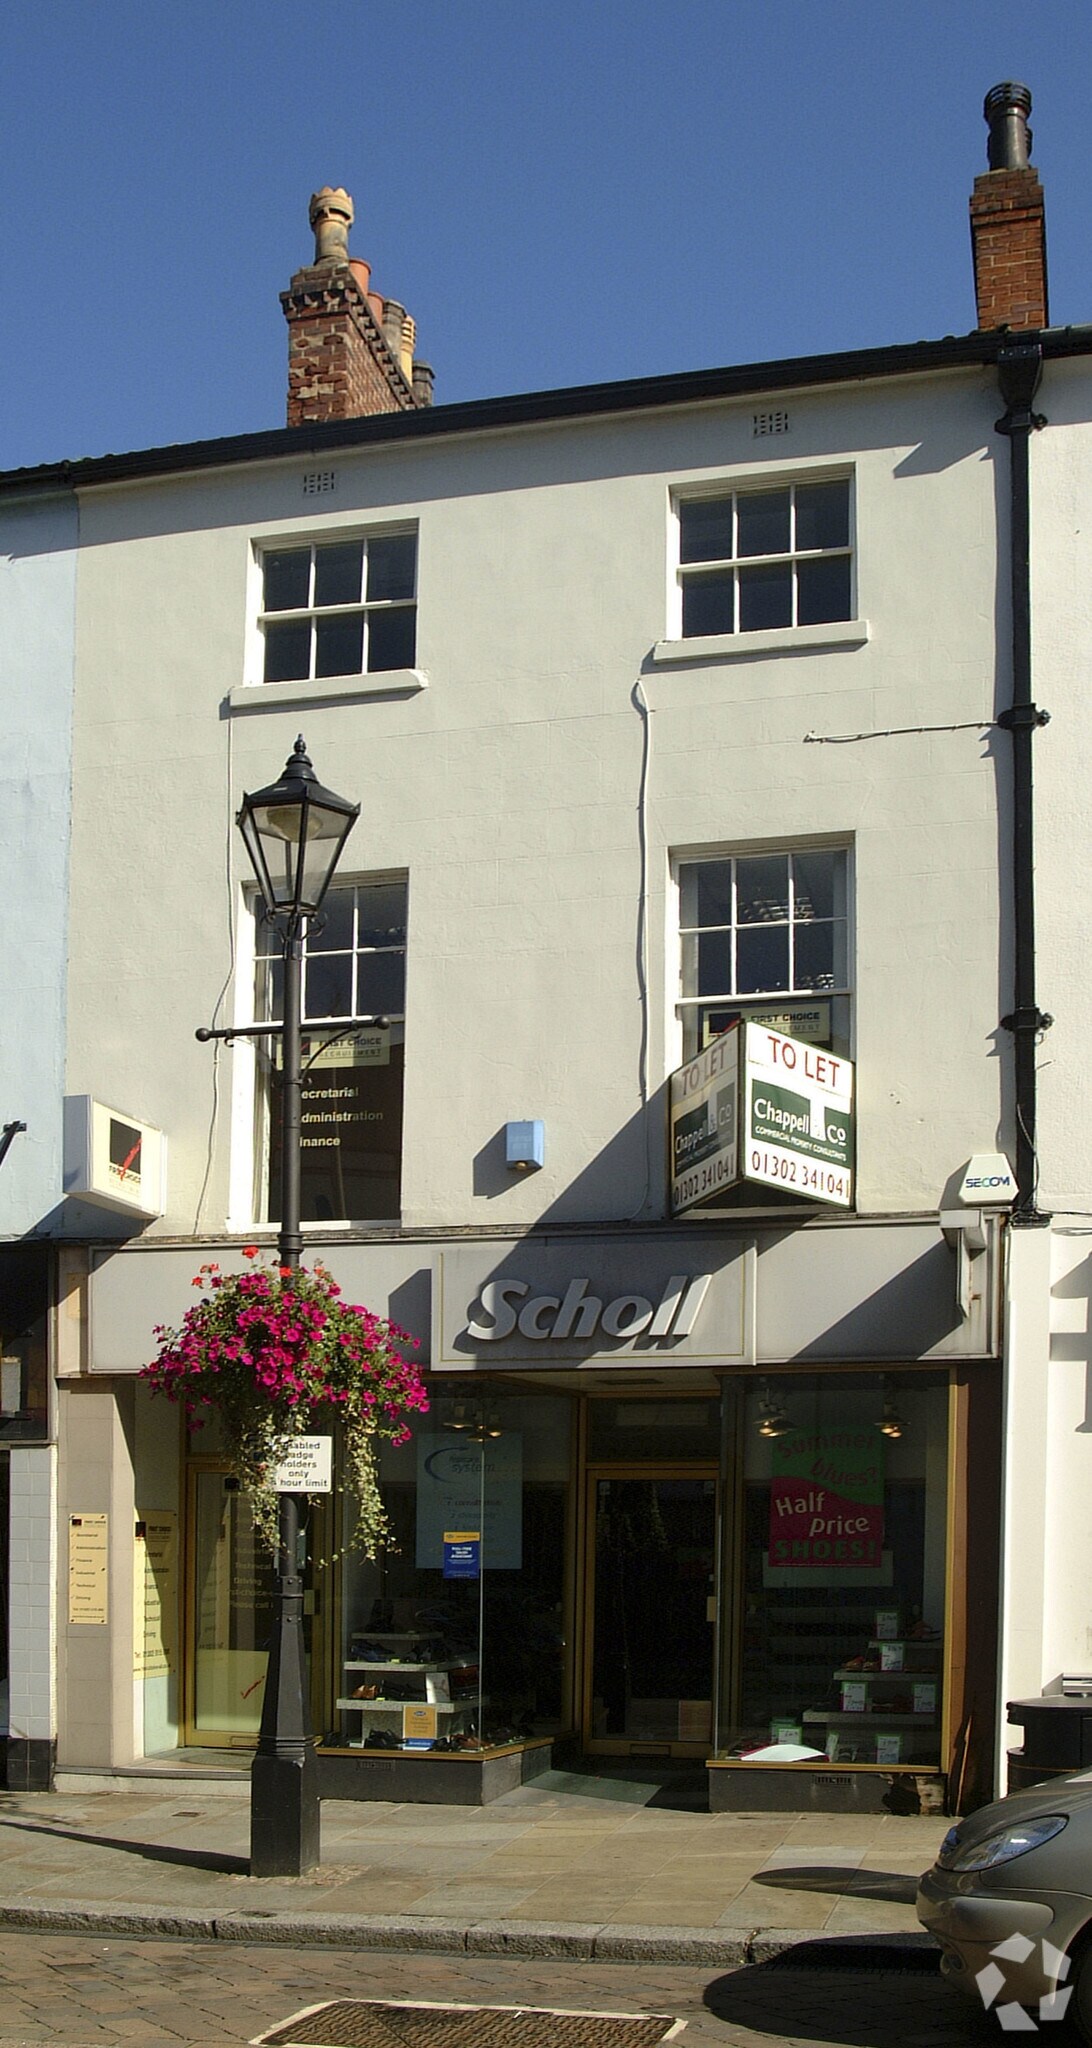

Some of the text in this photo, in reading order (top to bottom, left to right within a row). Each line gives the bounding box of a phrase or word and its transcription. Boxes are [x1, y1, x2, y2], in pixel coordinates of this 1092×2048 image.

[782, 1012, 820, 1022] CHOICE
[347, 1037, 382, 1046] CHOICE
[768, 1035, 840, 1088] TO LET
[681, 1041, 727, 1096] TO LET
[301, 1086, 358, 1099] ecretarial
[301, 1111, 383, 1123] dministration
[753, 1098, 810, 1135] Chappell
[299, 1136, 341, 1147] inance
[673, 1153, 734, 1206] 01302 341041
[752, 1150, 796, 1182] 01302
[802, 1165, 850, 1198] 341041
[966, 1176, 1010, 1188] SECOM
[467, 1274, 713, 1340] Scholl
[778, 1433, 875, 1458] Summer
[291, 1451, 314, 1459] adge
[280, 1460, 317, 1468] holders
[288, 1470, 309, 1478] only
[280, 1479, 302, 1487] hour
[305, 1479, 328, 1487] limit
[775, 1491, 825, 1517] Half
